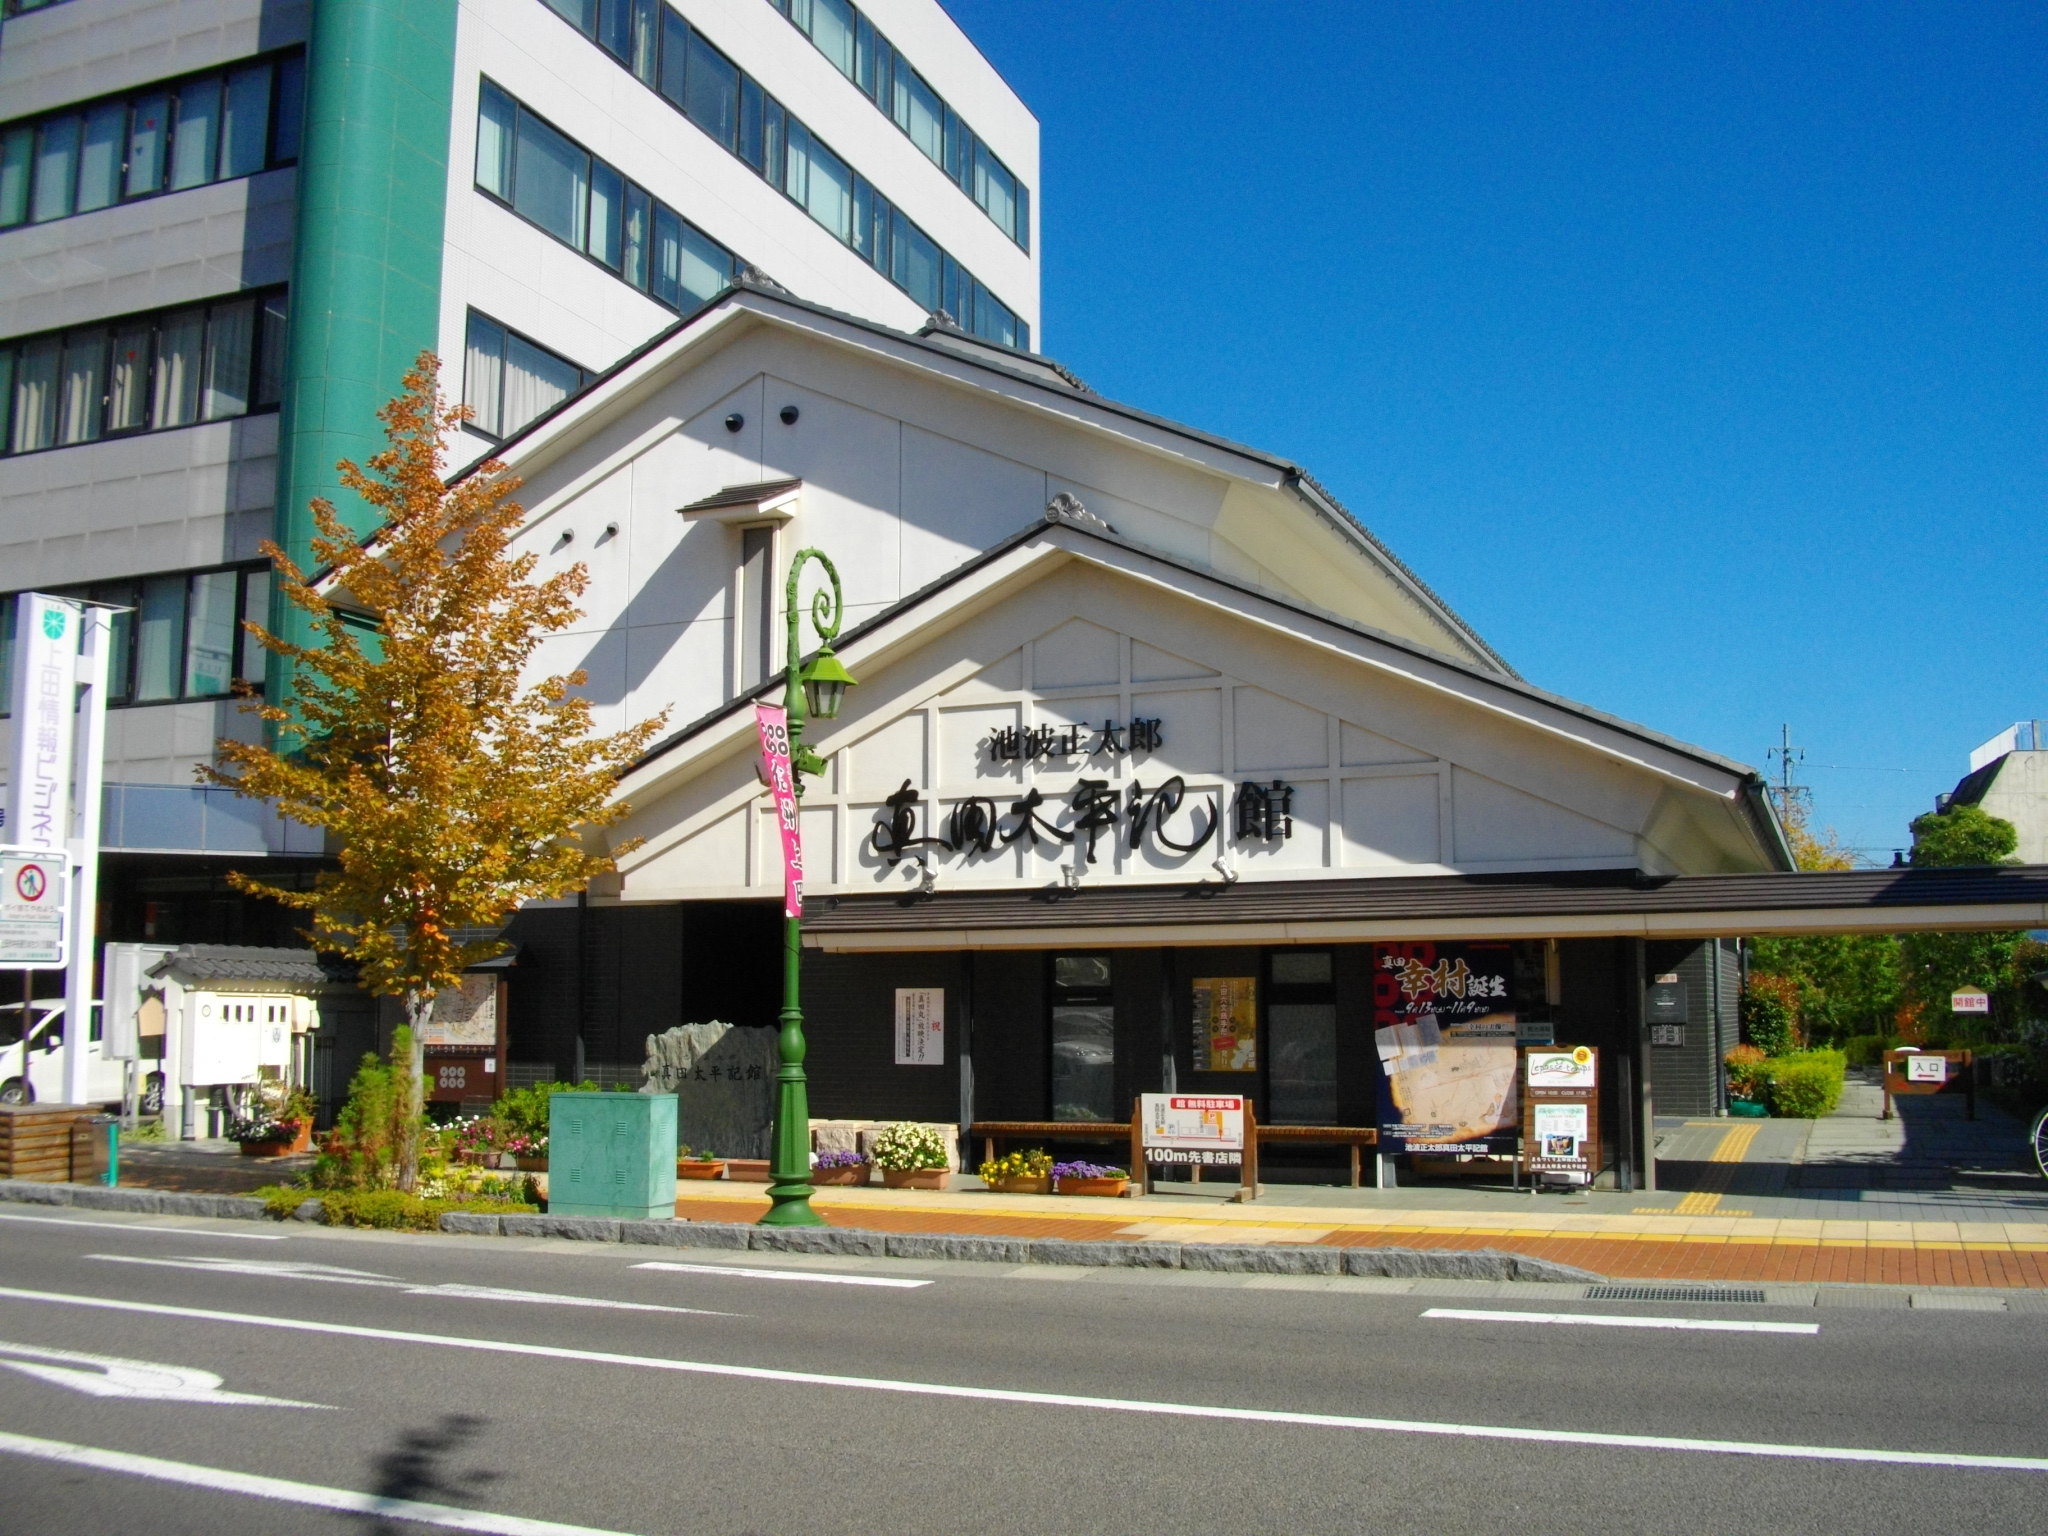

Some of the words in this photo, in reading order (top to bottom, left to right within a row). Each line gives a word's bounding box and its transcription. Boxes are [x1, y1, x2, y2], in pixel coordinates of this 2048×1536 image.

[989, 717, 1163, 762] 池波正太郎
[871, 775, 1295, 867] 真田太平記館
[1953, 997, 1986, 1008] 開館中
[931, 1020, 942, 1032] 祝
[661, 1063, 763, 1082] 真田太平記館
[1915, 1063, 1939, 1072] 入口
[1187, 1099, 1235, 1110] 無料駐車場
[1404, 1143, 1489, 1153] 池波正太郎真田太平記館
[1144, 1147, 1242, 1165] 100m先書店隣
